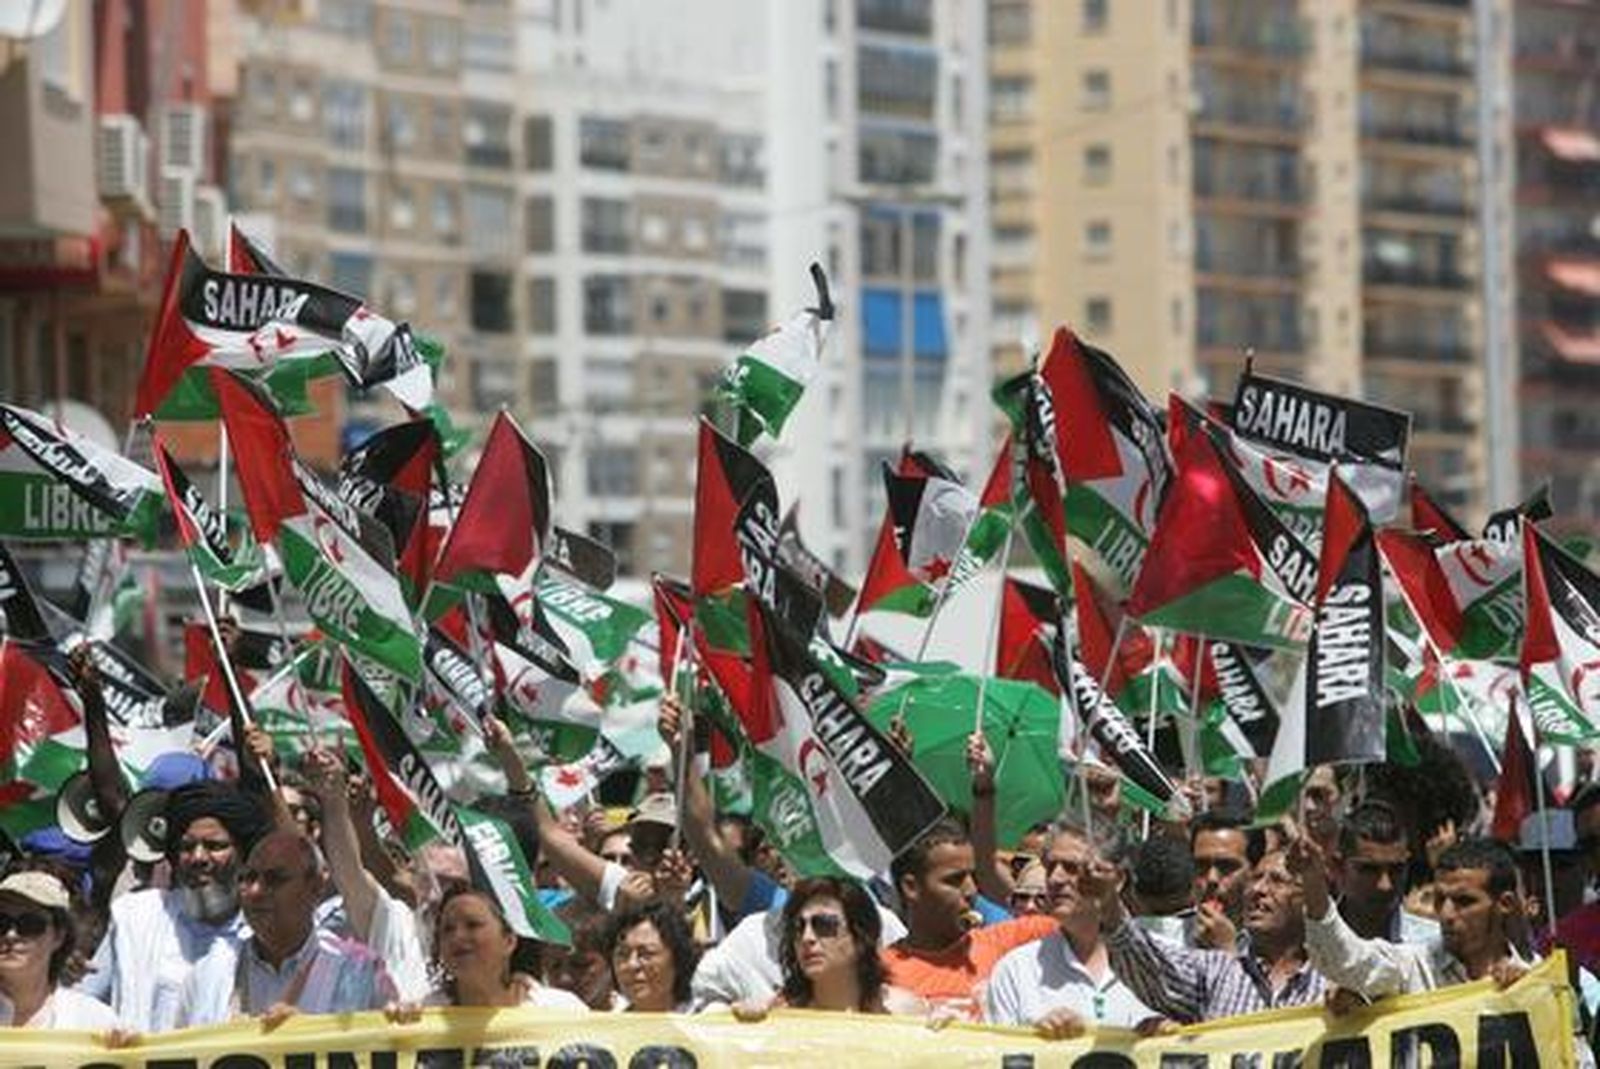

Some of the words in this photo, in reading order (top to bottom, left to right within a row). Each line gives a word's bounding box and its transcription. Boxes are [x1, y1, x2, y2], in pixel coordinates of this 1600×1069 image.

[1237, 386, 1347, 453] SAHARA
[1211, 642, 1266, 723] SAHARA
[1317, 584, 1371, 708] SAHARA
[801, 673, 893, 797] SAHARA
